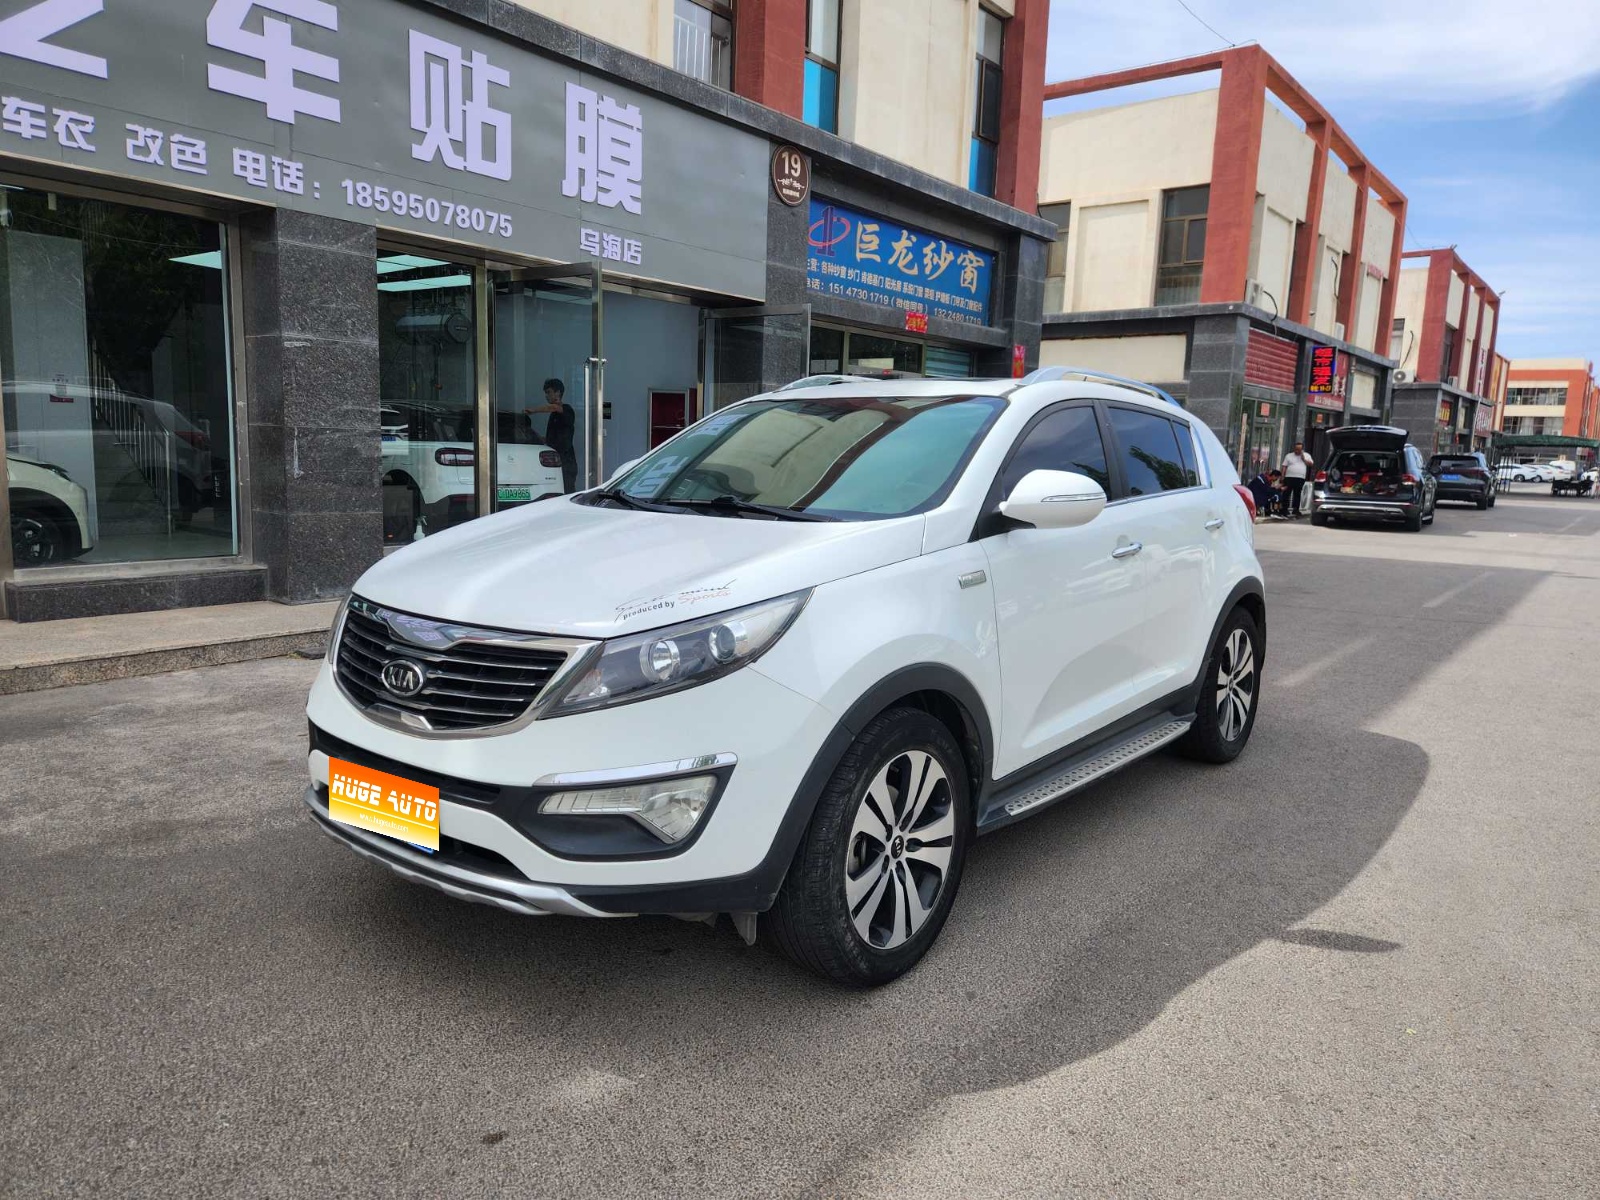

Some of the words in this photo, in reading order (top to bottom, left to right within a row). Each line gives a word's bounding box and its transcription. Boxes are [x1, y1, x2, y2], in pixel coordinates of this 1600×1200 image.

[2, 96, 95, 152] 车衣
[125, 123, 208, 175] 改色
[341, 179, 513, 238] 18595078075
[781, 152, 801, 177] 19
[580, 227, 642, 265] 乌海店
[856, 220, 985, 294] 巨龙纱窗
[828, 281, 844, 295] 151
[846, 287, 868, 300] 4730
[869, 292, 889, 305] 1719
[623, 602, 663, 620] produced
[664, 601, 675, 609] by
